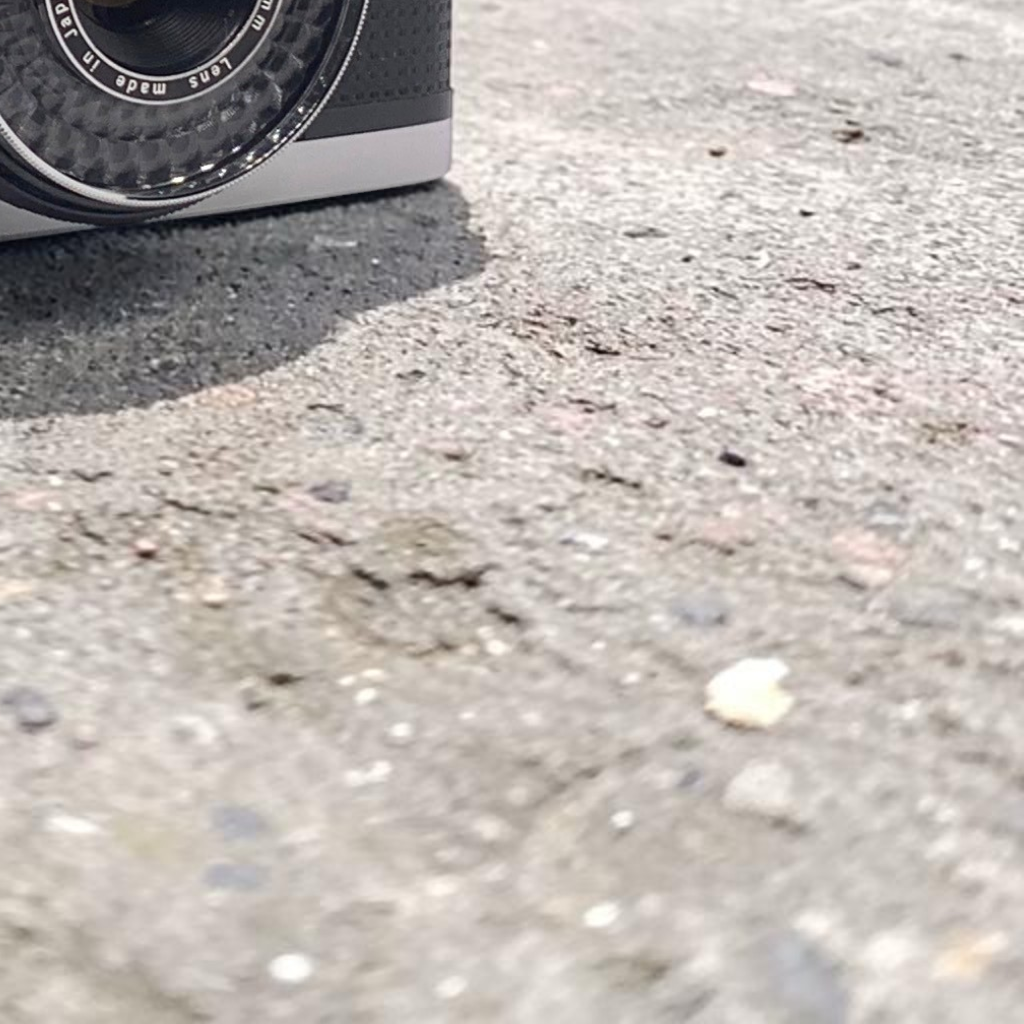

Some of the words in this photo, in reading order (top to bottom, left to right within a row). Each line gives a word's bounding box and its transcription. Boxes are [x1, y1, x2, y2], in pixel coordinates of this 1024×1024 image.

[82, 50, 101, 73] in
[188, 57, 233, 89] Lens
[115, 74, 167, 96] made
